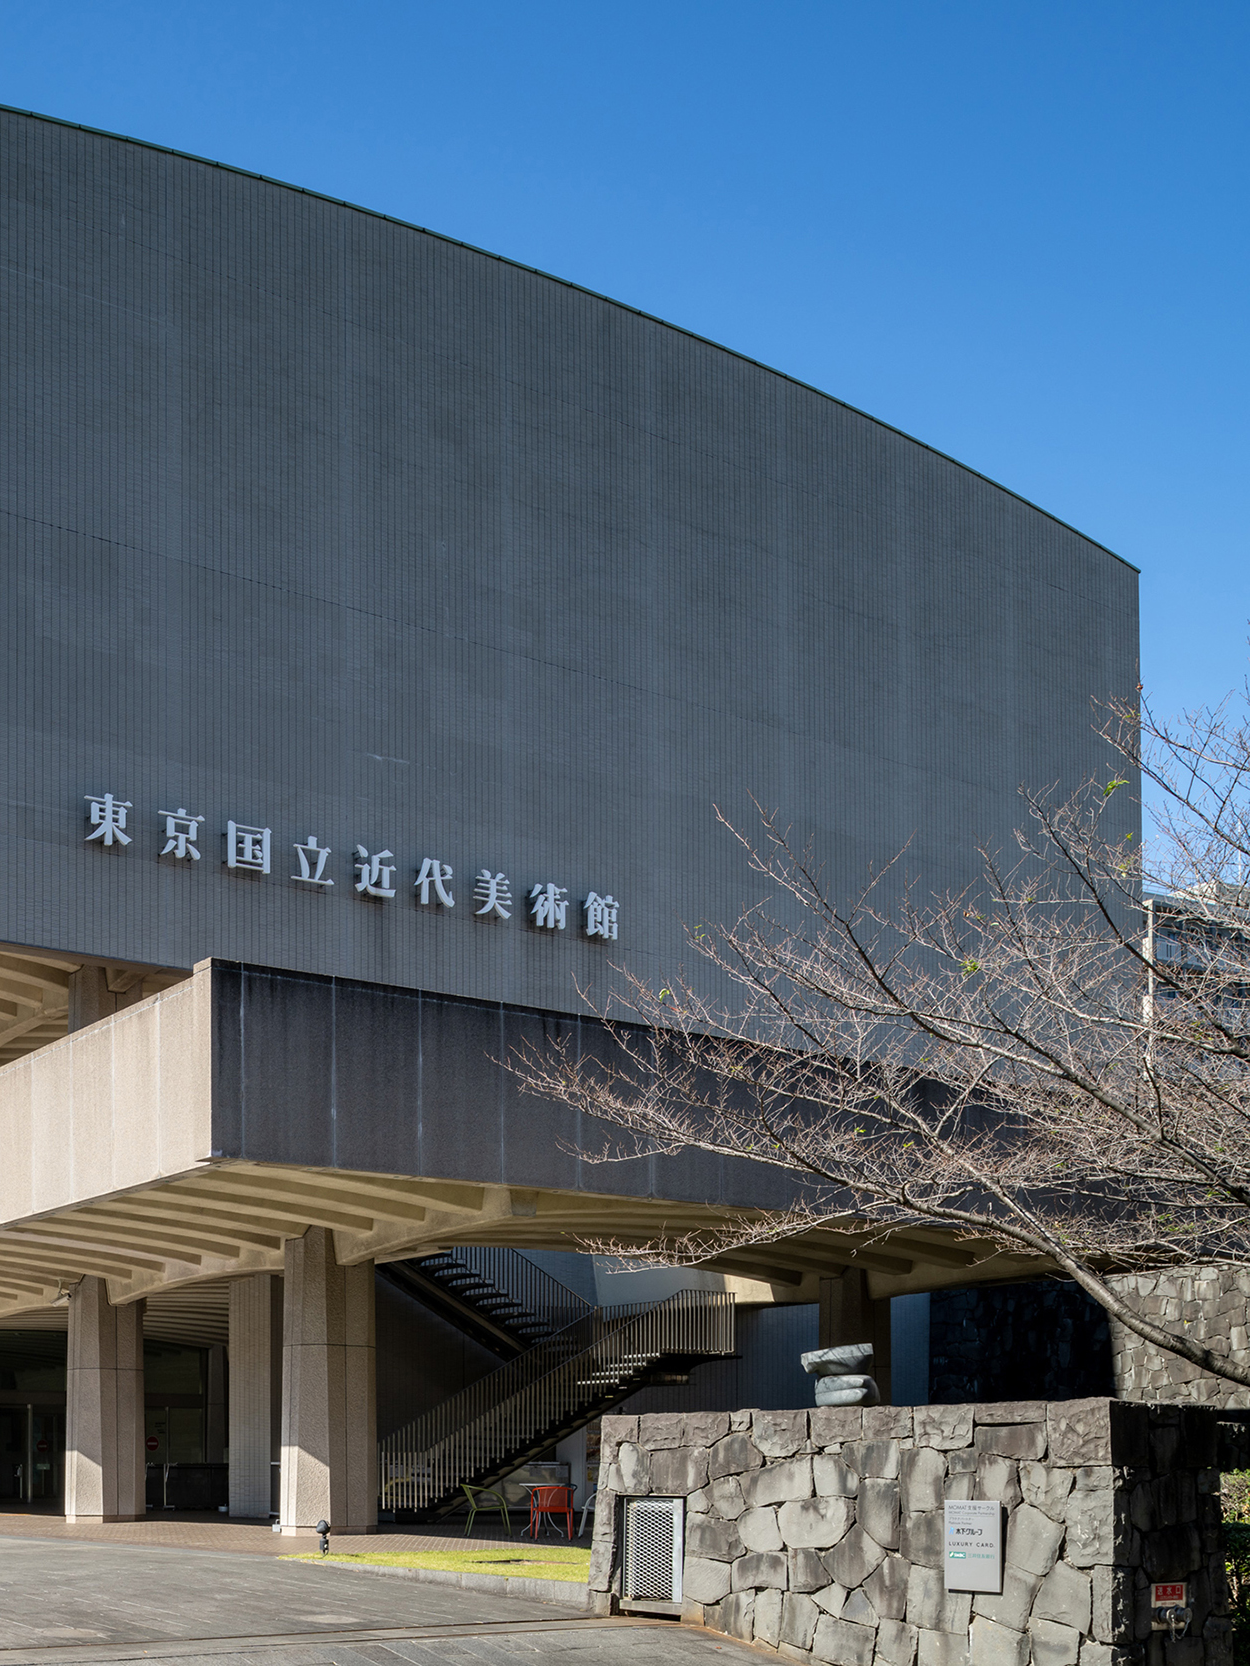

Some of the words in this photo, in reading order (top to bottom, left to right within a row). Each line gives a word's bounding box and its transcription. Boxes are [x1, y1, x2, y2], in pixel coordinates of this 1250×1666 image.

[84, 793, 620, 940] 東京国立近代美術館
